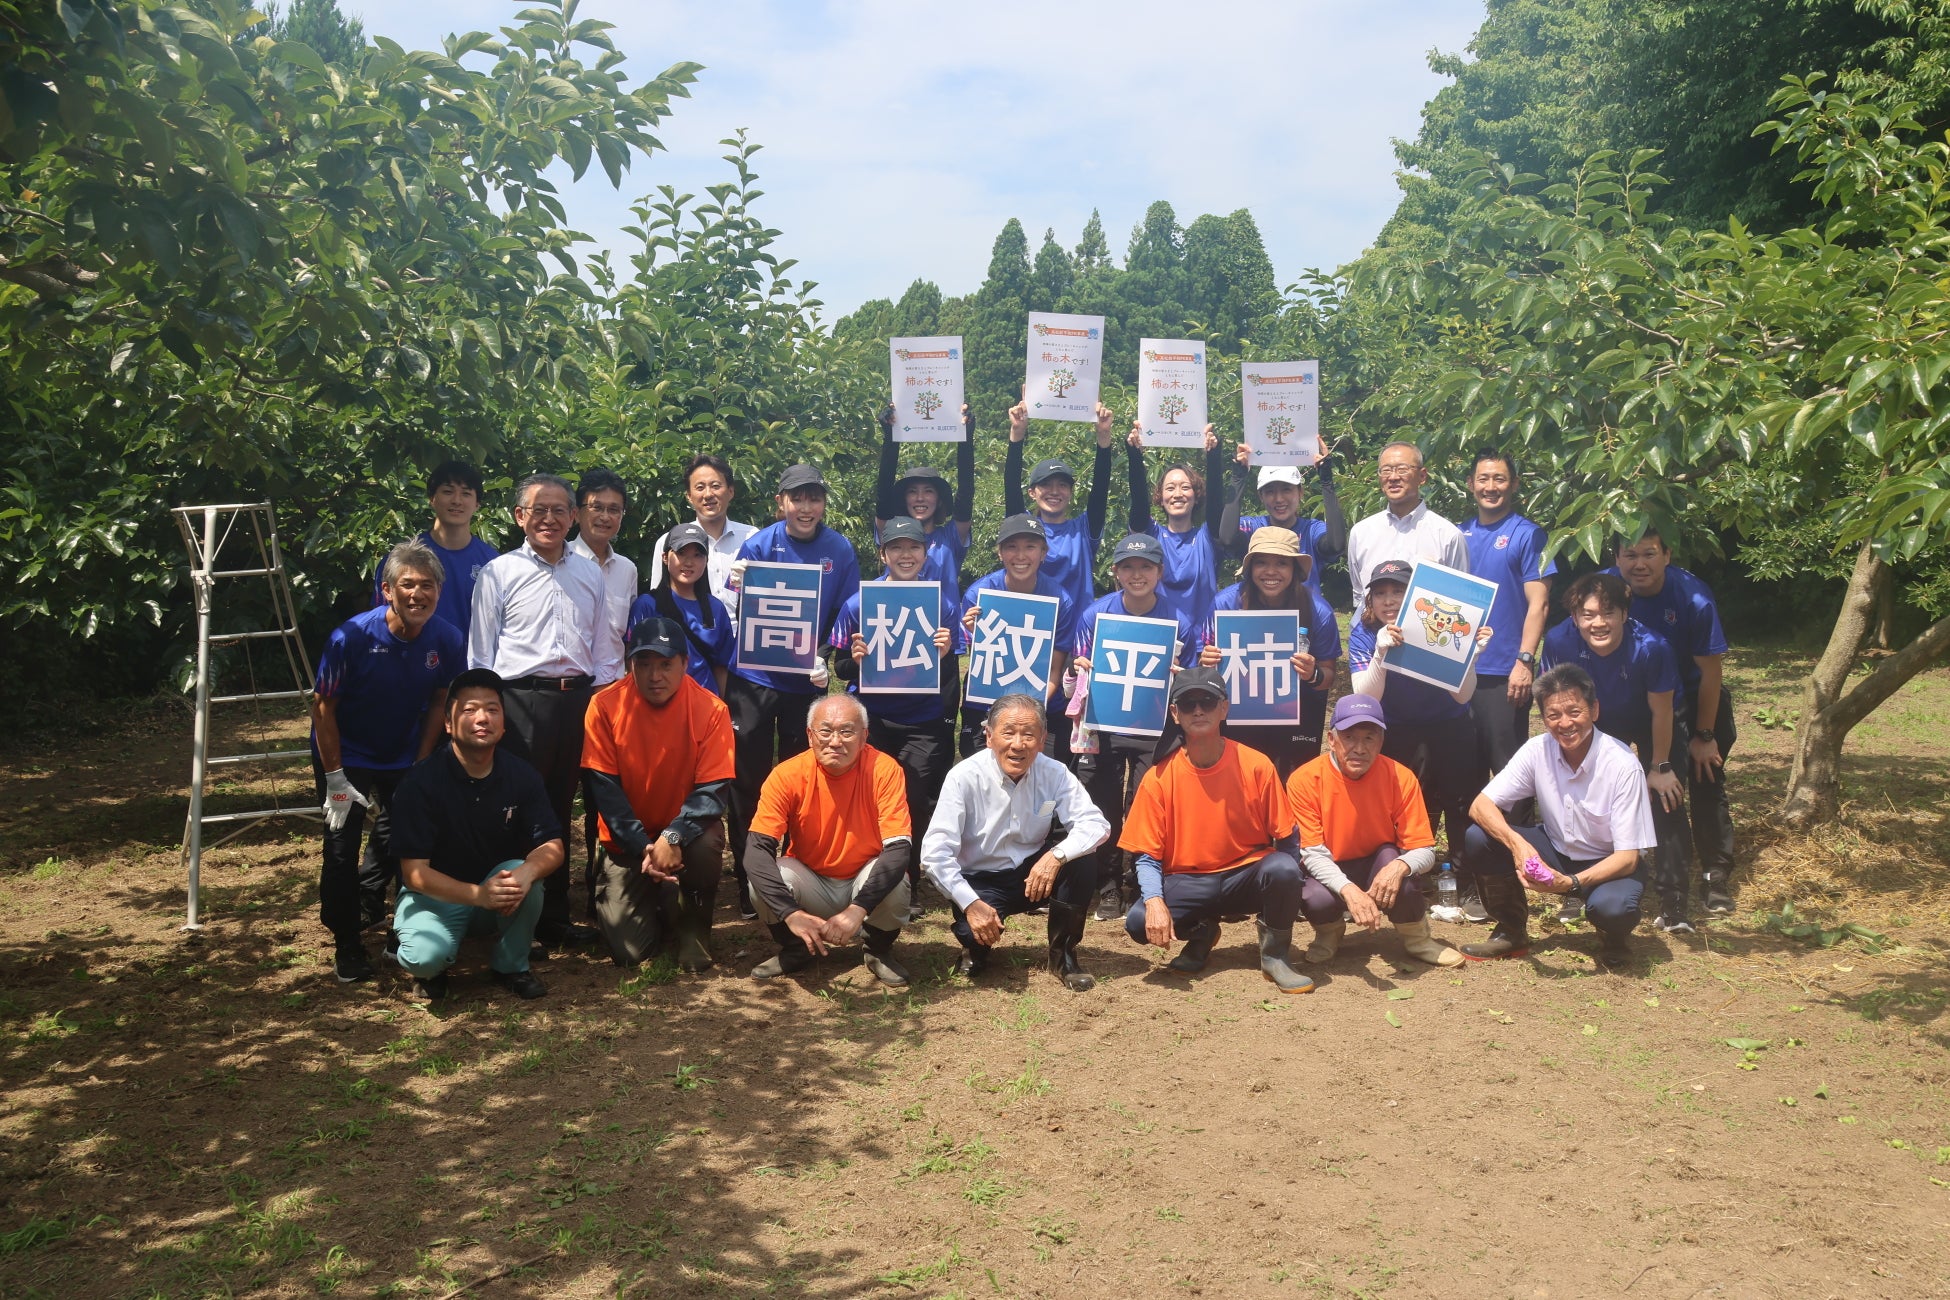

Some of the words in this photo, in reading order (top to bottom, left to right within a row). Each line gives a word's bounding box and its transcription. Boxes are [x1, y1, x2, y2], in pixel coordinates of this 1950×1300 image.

[744, 581, 817, 655] 高
[866, 603, 935, 672] 松
[970, 608, 1052, 692] 紋
[1094, 639, 1167, 712] 平
[1220, 632, 1295, 705] 柿
